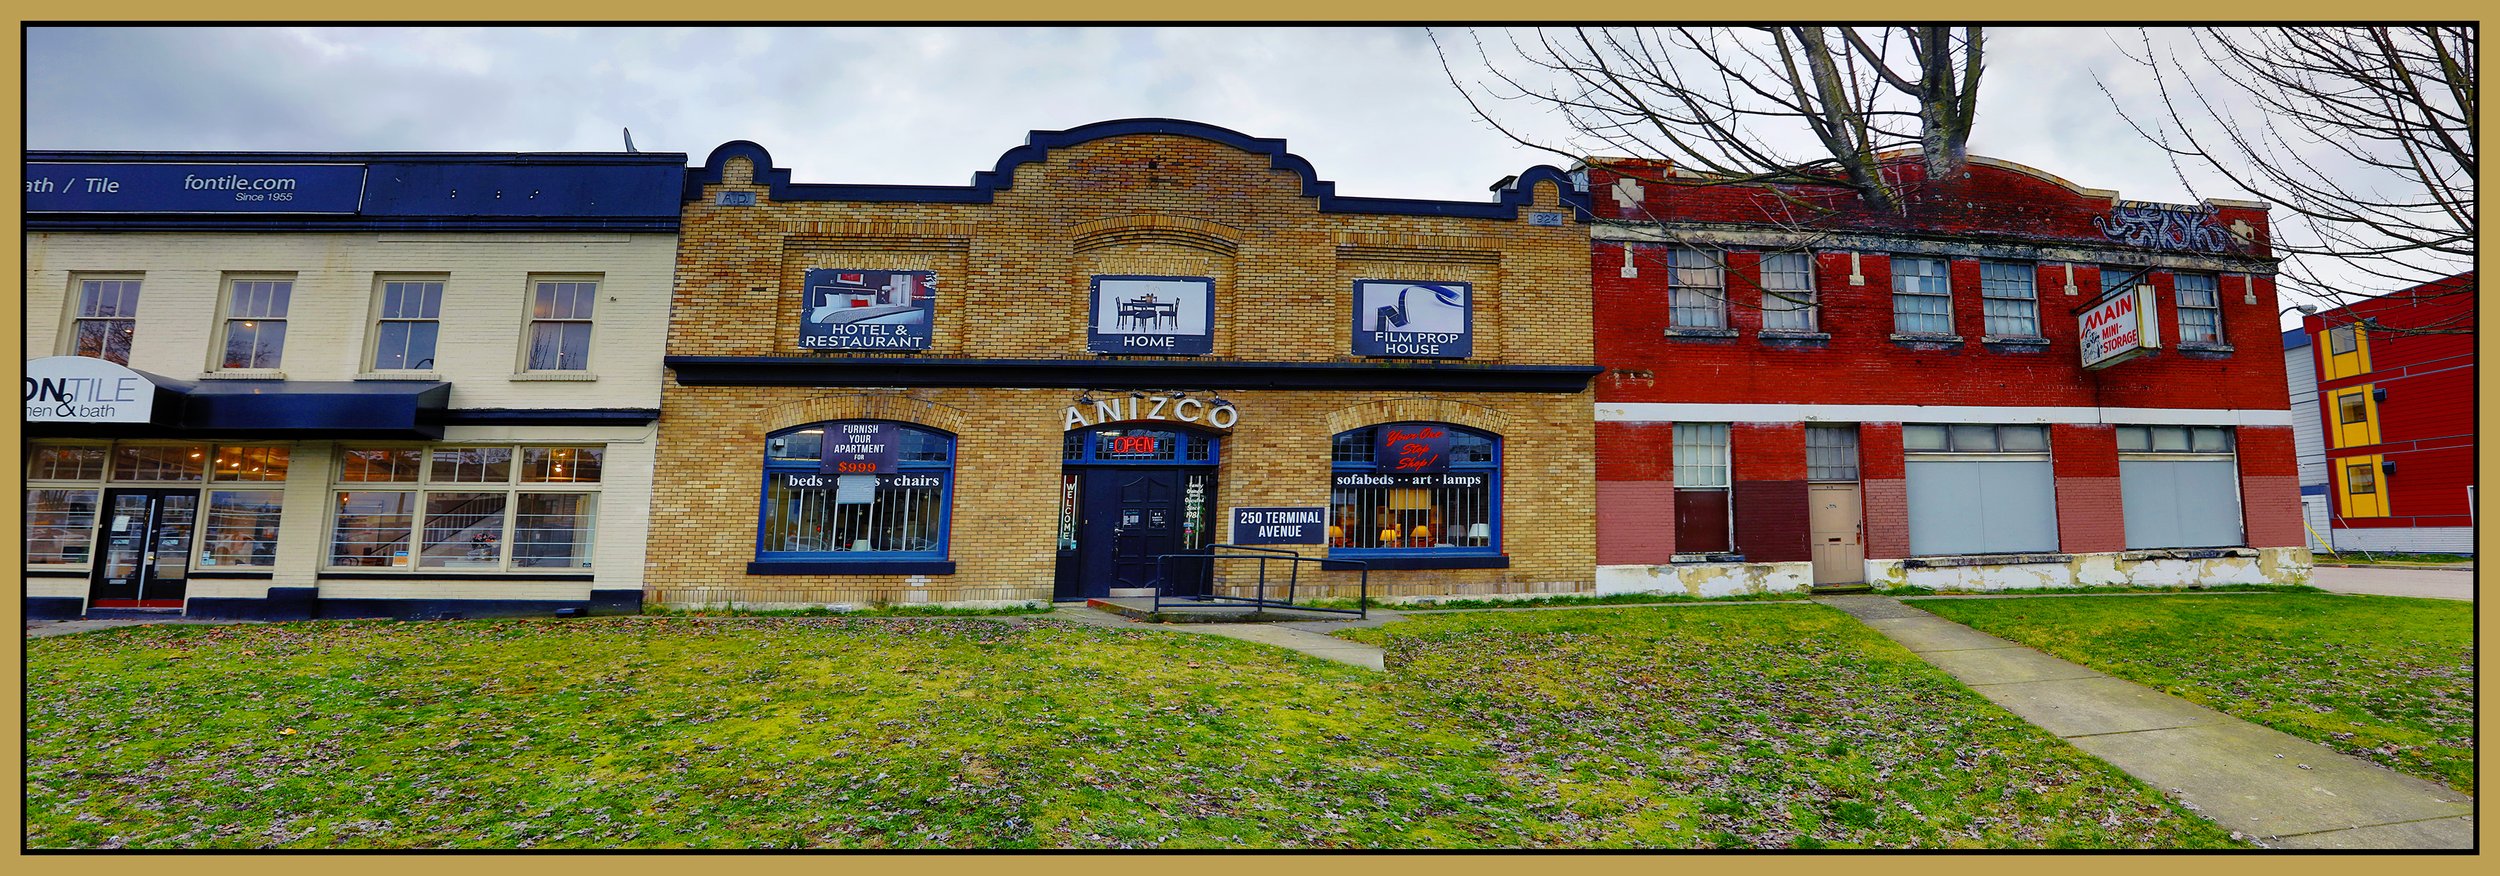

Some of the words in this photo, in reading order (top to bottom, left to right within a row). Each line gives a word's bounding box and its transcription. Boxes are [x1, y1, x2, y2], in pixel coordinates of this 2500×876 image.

[85, 177, 120, 193] Tile
[184, 174, 296, 191] fontile.com
[235, 192, 264, 201] Since
[267, 192, 293, 201] 1955
[722, 193, 749, 204] A.D.
[2081, 295, 2132, 339] MAIN
[832, 324, 890, 336] HOTEL
[895, 325, 908, 336] &
[805, 336, 923, 348] RESTAURANT
[1123, 335, 1175, 347] HOME
[1375, 331, 1412, 343] FILM
[1417, 333, 1459, 344] PROP
[2103, 329, 2137, 354] STORAGE
[1385, 343, 1440, 355] HOUSE
[56, 393, 77, 418] &
[80, 404, 115, 418] bath
[1064, 396, 1238, 431] ANIZCO
[842, 424, 879, 434] FURNISH
[849, 434, 872, 443] YOUR
[1385, 429, 1417, 447] Your
[1418, 427, 1445, 440] One
[834, 444, 885, 453] APARTMENT
[1113, 436, 1155, 453] OPEN
[1399, 443, 1431, 457] Stop
[838, 461, 877, 473] $999
[1395, 454, 1439, 471] Shop!
[788, 474, 823, 487] beds
[893, 474, 940, 487] chairs
[1336, 474, 1394, 486] sofabeds
[1412, 475, 1433, 486] art
[1442, 474, 1481, 487] lamps
[1063, 483, 1075, 540] WELCOME
[1240, 511, 1262, 524] 250
[1265, 511, 1321, 524] TERMINAL
[1258, 525, 1302, 538] AVENUE
